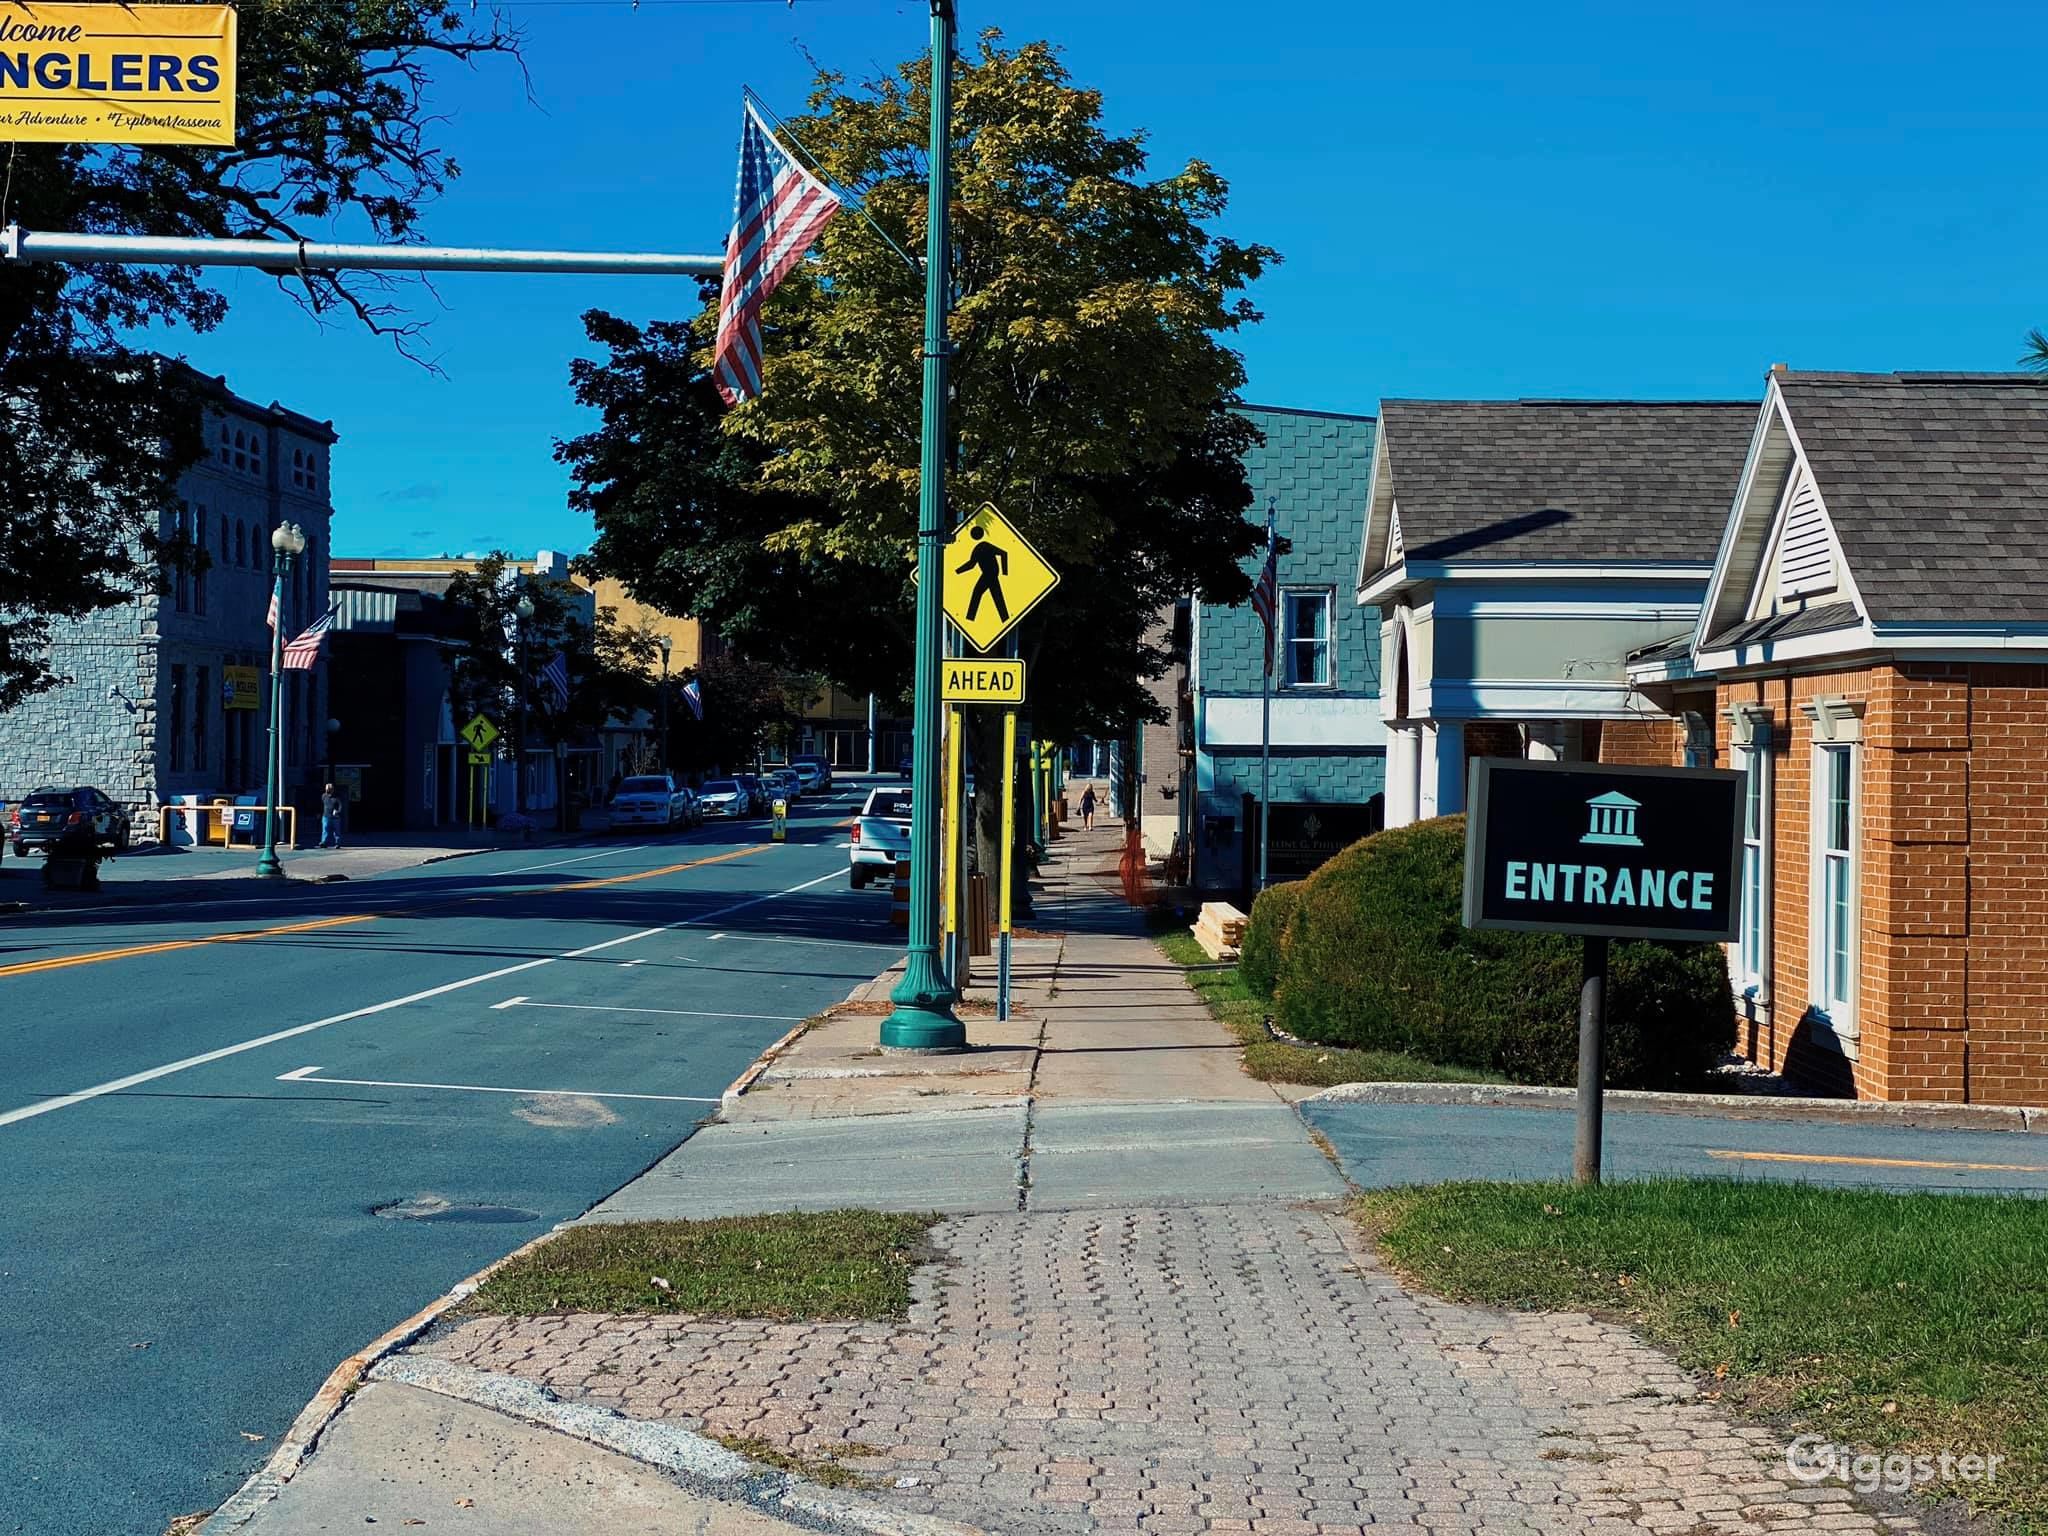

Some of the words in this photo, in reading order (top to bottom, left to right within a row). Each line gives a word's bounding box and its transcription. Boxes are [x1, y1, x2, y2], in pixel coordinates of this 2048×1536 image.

[0, 52, 220, 93] NGLERS
[15, 111, 88, 126] Adventure
[107, 112, 222, 130] #ExploreMassena
[948, 670, 1014, 691] AHEAD
[1505, 861, 1715, 910] ENTRANCE
